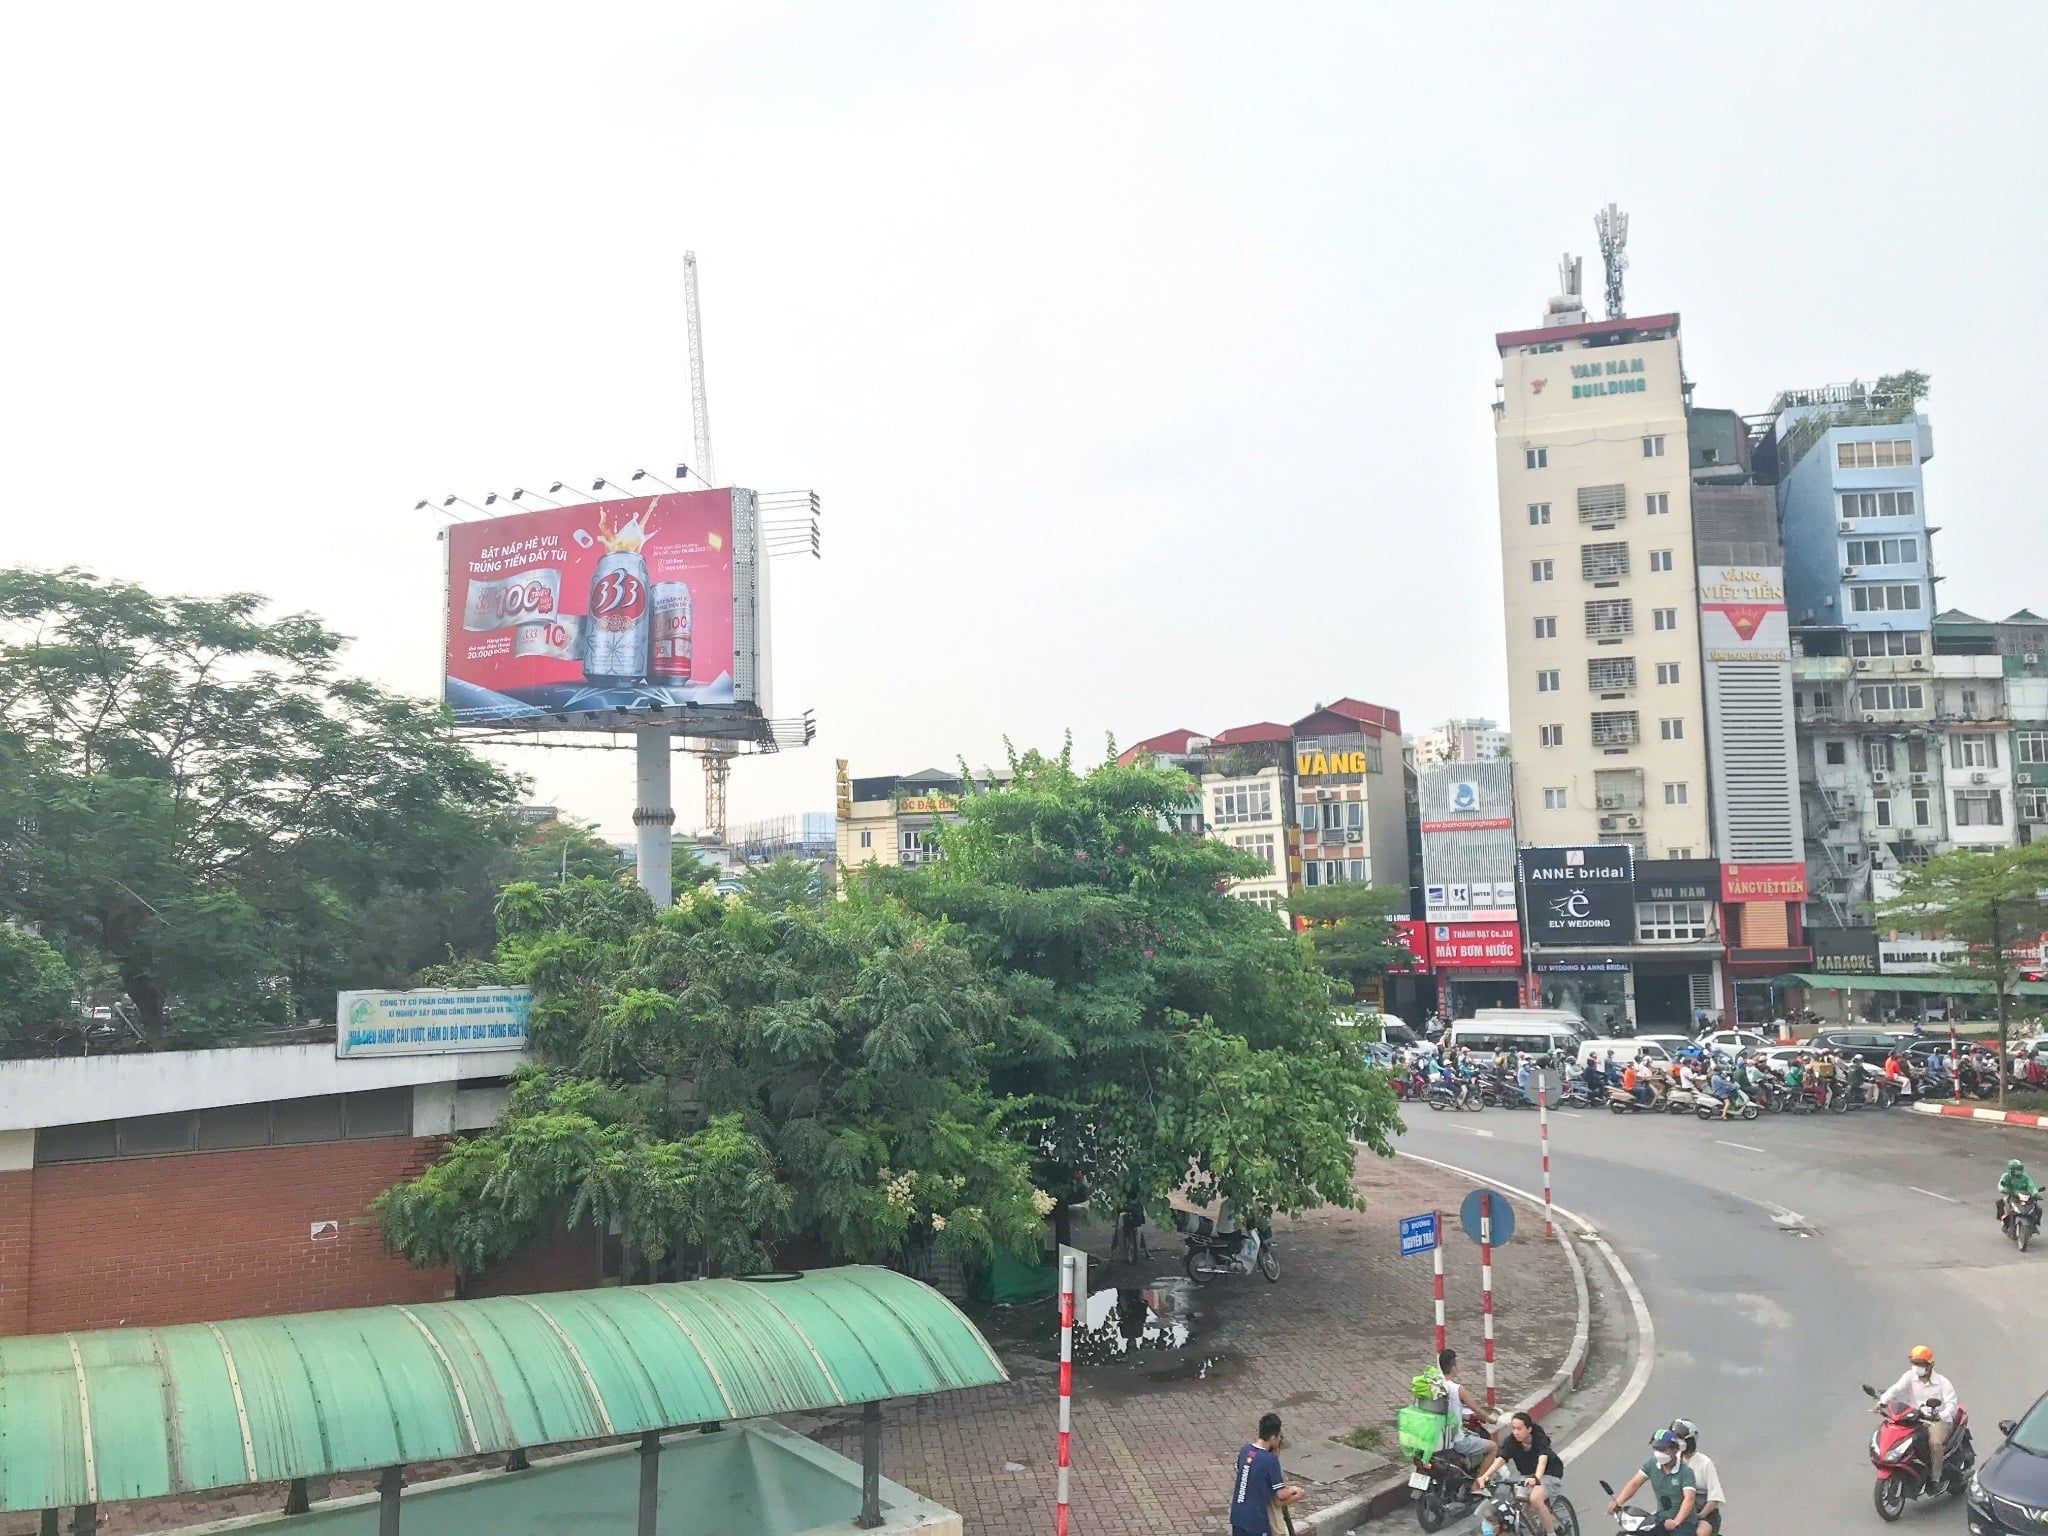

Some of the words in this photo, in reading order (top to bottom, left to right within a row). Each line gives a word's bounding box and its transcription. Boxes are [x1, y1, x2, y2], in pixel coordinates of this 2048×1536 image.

[1572, 377, 1646, 399] BUILDING
[481, 546, 500, 559] BẬT
[525, 536, 540, 549] HÈ
[541, 536, 558, 547] VUI
[551, 549, 567, 561] TÚI
[595, 568, 638, 613] 333
[1297, 747, 1367, 776] VÀNG
[1532, 868, 1575, 880] ANNE
[1579, 867, 1624, 878] bridal
[1650, 887, 1673, 898] VAN
[1679, 887, 1706, 897] NAM
[1727, 879, 1755, 894] VÀNG
[1549, 920, 1565, 928] ELY
[1567, 919, 1611, 928] WEDDING
[1436, 943, 1457, 958] MÁY
[1461, 944, 1483, 957] BƠM
[1486, 941, 1514, 957] NƯỚC
[1816, 955, 1874, 970] KARAOKE
[1883, 952, 1928, 963] BILLIARDS
[1931, 952, 1937, 962] &
[1237, 1465, 1250, 1503] VINSCHOOL
